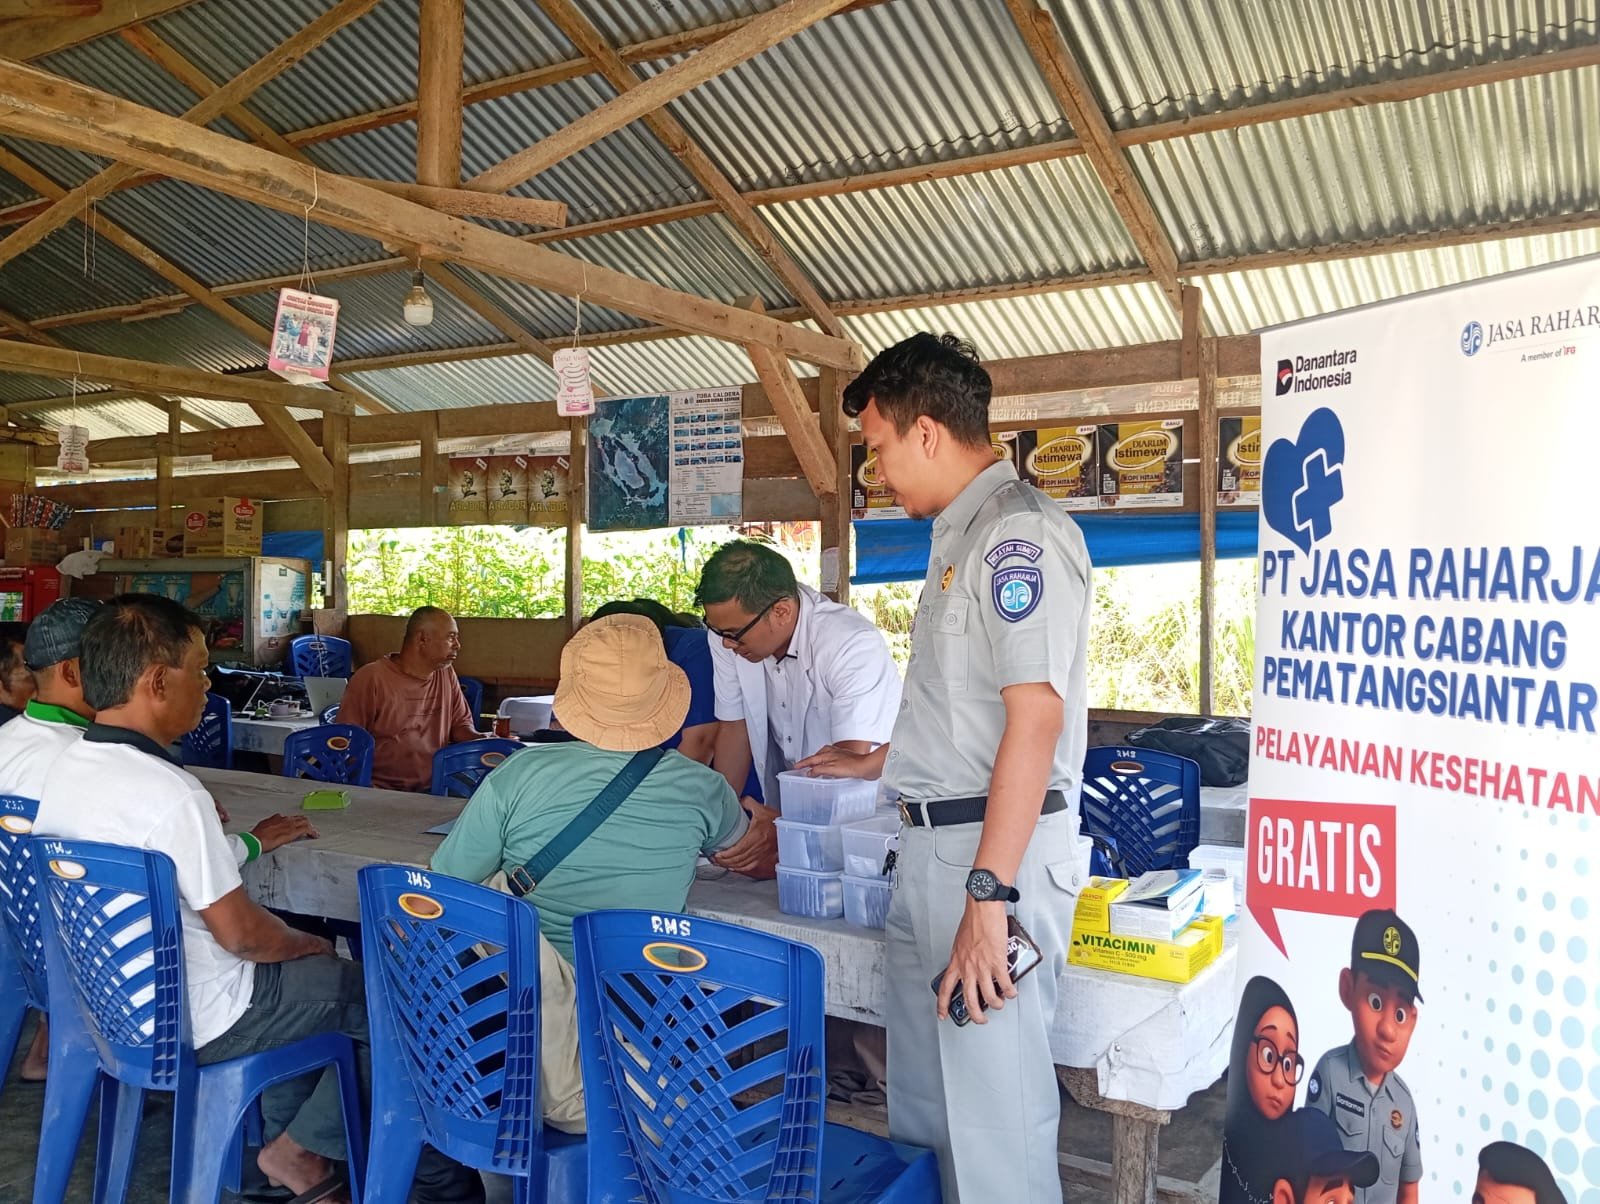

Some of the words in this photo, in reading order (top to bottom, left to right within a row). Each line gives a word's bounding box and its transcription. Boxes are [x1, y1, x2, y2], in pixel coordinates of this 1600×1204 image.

[1487, 319, 1525, 347] JASA
[1530, 304, 1600, 336] RAHAR
[1296, 349, 1357, 373] Danantara
[1528, 350, 1553, 361] member
[1554, 348, 1562, 357] of
[1294, 368, 1352, 393] Indonesia
[1033, 453, 1082, 464] Istimewa
[1115, 448, 1167, 458] Istimewa
[1262, 550, 1294, 596] PT
[1300, 548, 1398, 599] JASA
[1408, 545, 1600, 604] RAHARJA
[1281, 609, 1407, 658] KANTOR
[1414, 614, 1568, 671] CABANG
[1263, 656, 1598, 734] PEMATANGSIANTAR
[1256, 725, 1404, 781] PELAYANAN
[1409, 749, 1600, 817] KESEHATAN
[1257, 815, 1382, 898] GRATIS
[651, 915, 691, 936] RMS
[1081, 934, 1156, 955] VITACIMIN
[1092, 947, 1115, 956] Vitamin
[1125, 951, 1136, 959] 500
